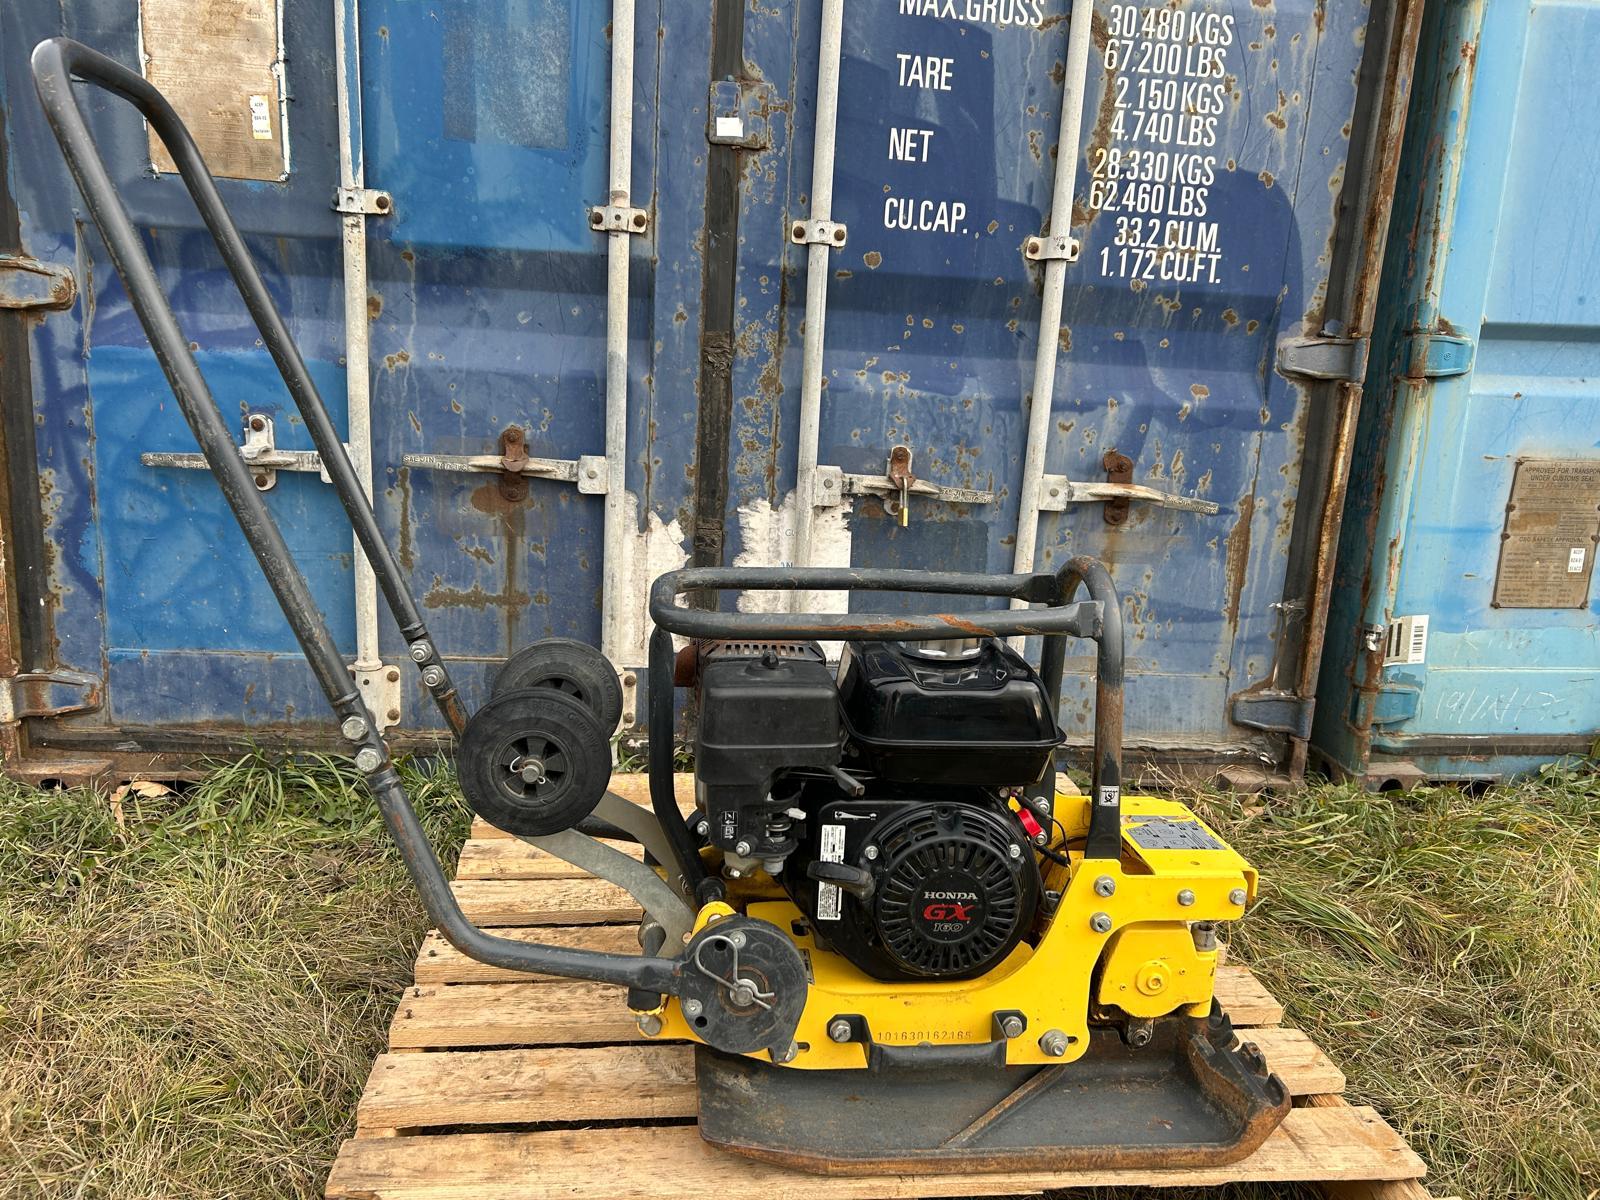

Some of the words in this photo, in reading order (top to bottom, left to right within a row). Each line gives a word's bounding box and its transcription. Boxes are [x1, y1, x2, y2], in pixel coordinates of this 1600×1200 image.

[1108, 5, 1185, 41] 30,480
[1189, 12, 1234, 45] KGS
[896, 53, 954, 90] TARE
[1104, 40, 1181, 74] 67,200
[1185, 46, 1226, 78] LBS
[1114, 77, 1177, 111] 2,150
[1180, 82, 1225, 114] KGS
[888, 128, 934, 162] NET
[1110, 110, 1173, 143] 4,740
[1177, 115, 1217, 146] LBS
[1093, 148, 1168, 182] 28,330
[1172, 153, 1216, 185] KGS
[884, 198, 967, 234] CU.CAP.
[1090, 181, 1165, 213] 62,460
[1168, 185, 1208, 216] LBS
[1114, 216, 1160, 248] 33.2
[1164, 220, 1221, 252] CU.M.
[1100, 247, 1157, 279] 1,172
[1161, 251, 1221, 283] CU.FT.
[923, 904, 976, 920] GX
[924, 891, 978, 900] HONDA
[933, 923, 963, 932] 160
